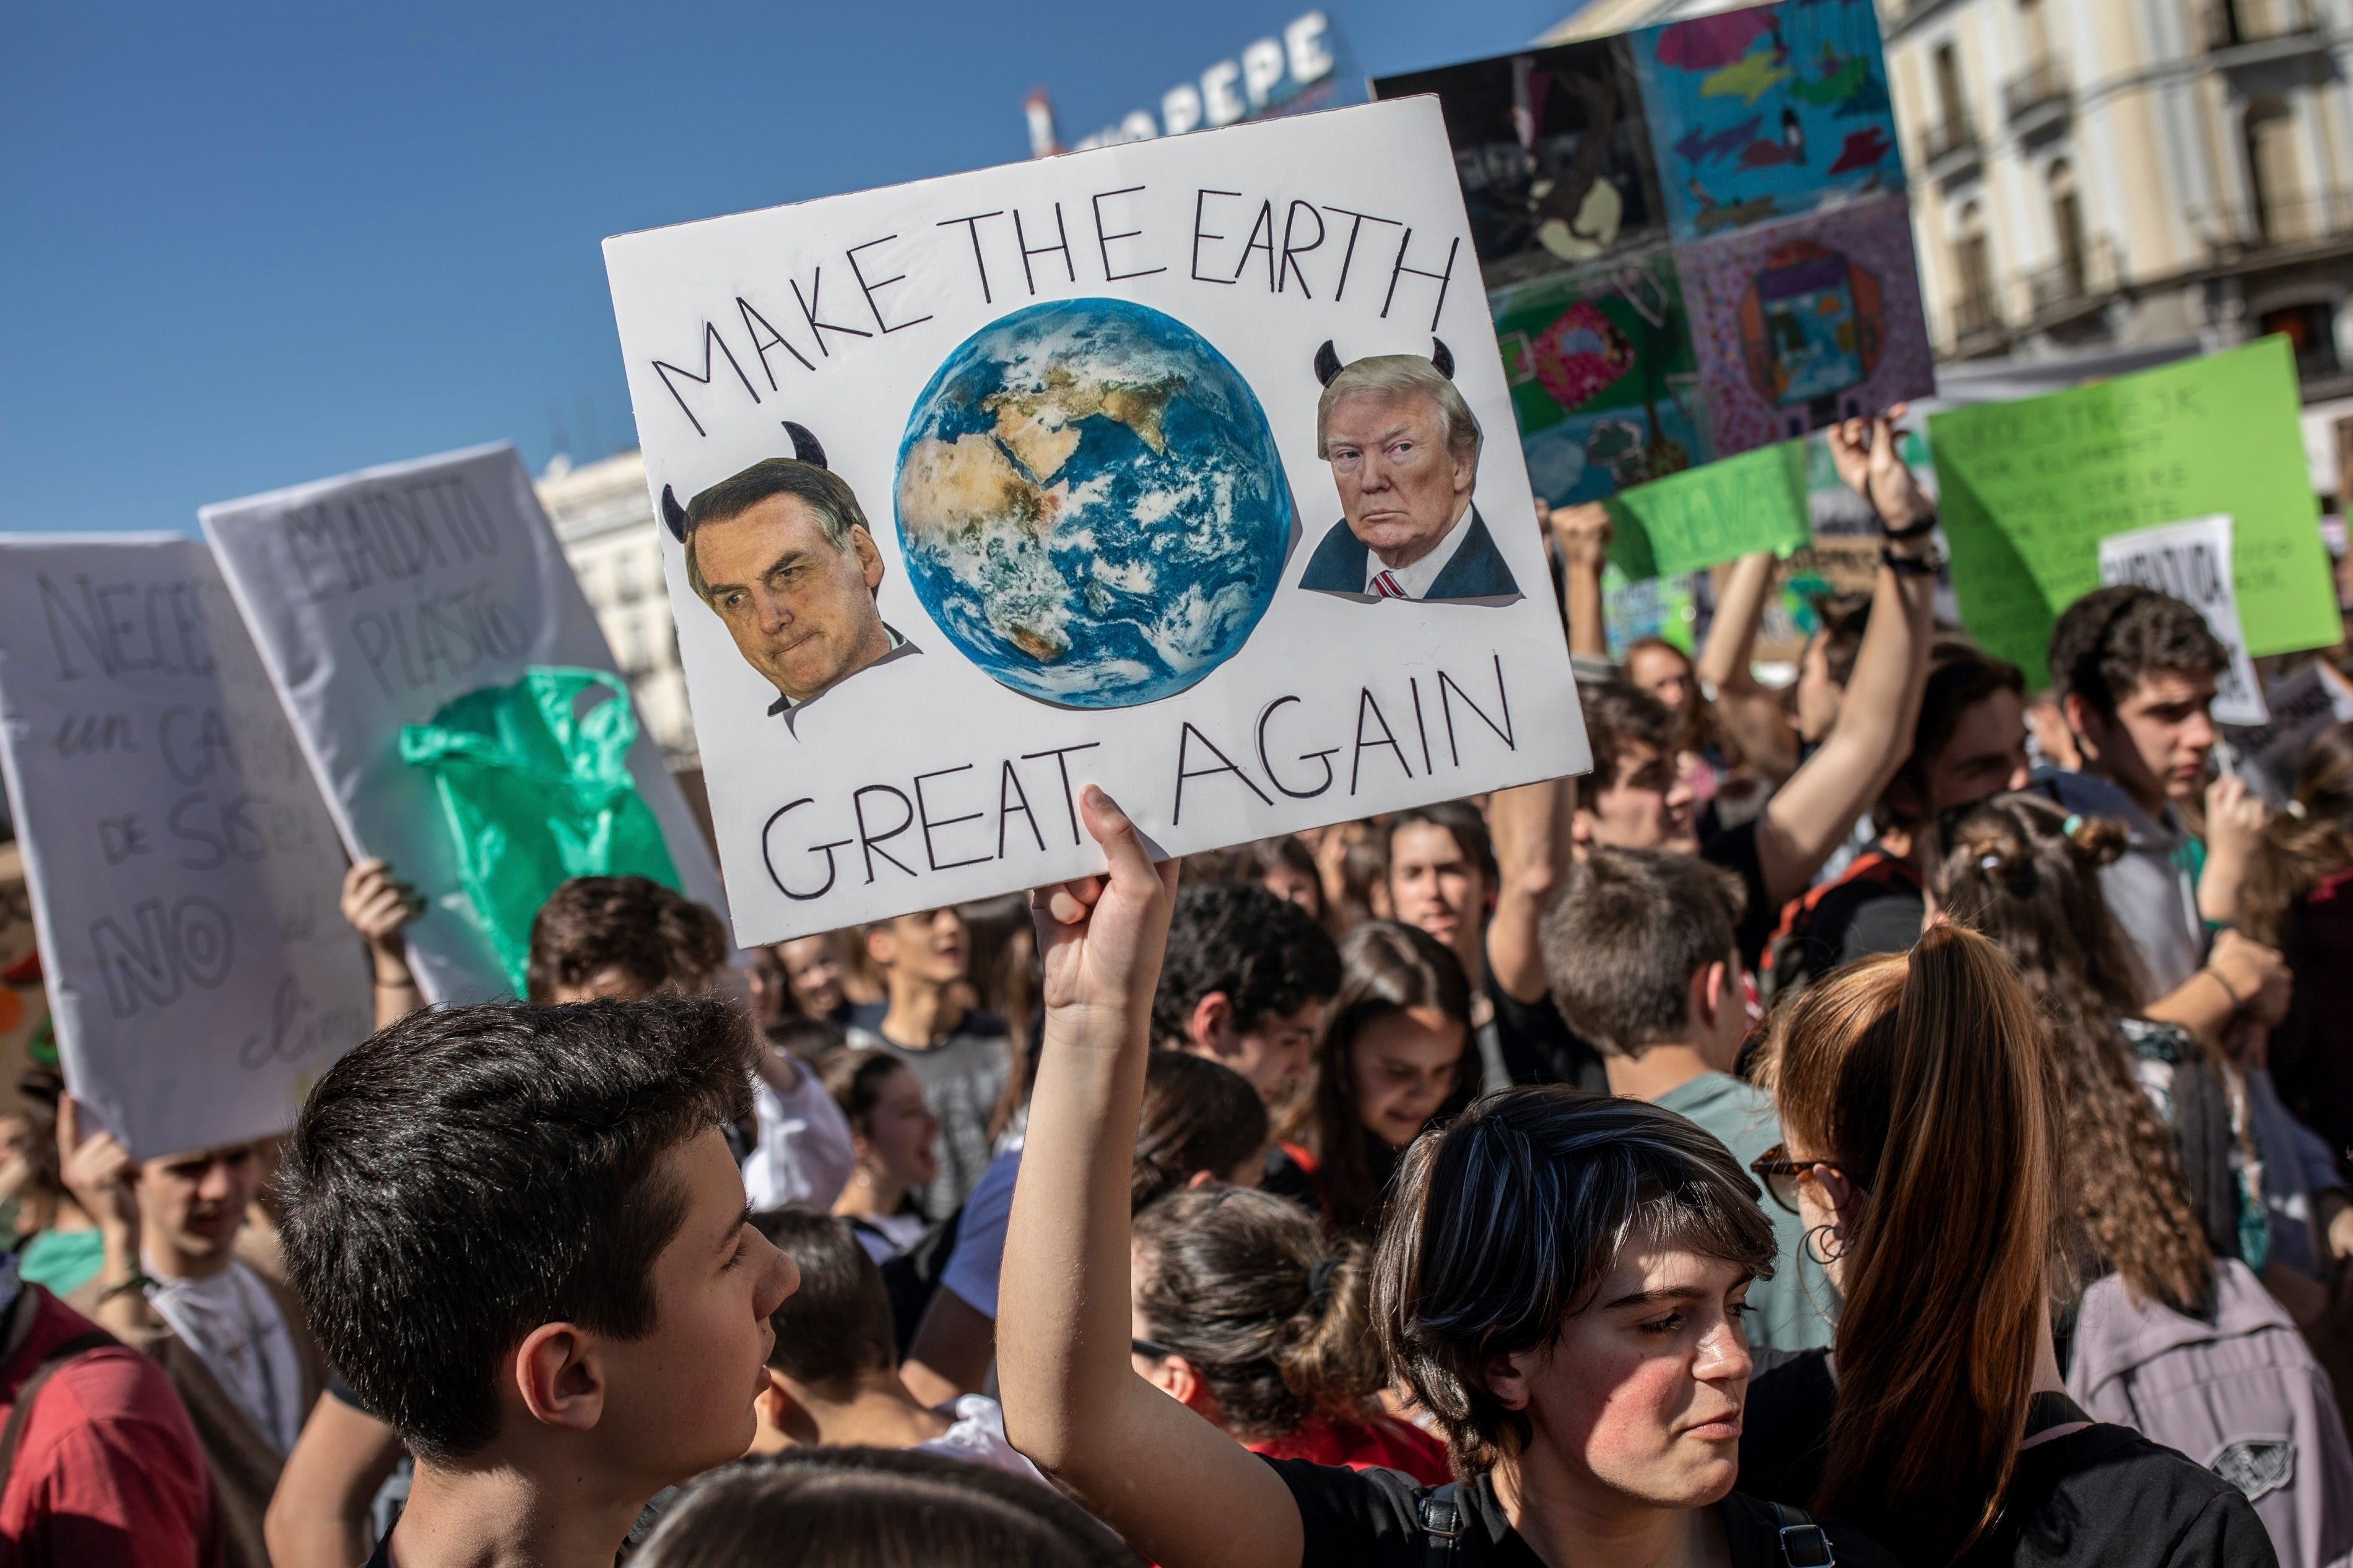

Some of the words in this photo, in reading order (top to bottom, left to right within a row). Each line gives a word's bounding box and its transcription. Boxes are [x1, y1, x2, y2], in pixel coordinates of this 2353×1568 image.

[1162, 9, 1335, 135] PEPE
[652, 234, 933, 437] MAKE
[936, 186, 1167, 304] THE
[1191, 188, 1460, 332] EARTH
[96, 810, 155, 865] DE
[762, 742, 1100, 901] GREAT
[1173, 653, 1517, 826] AGAIN
[88, 893, 235, 1020] NO
